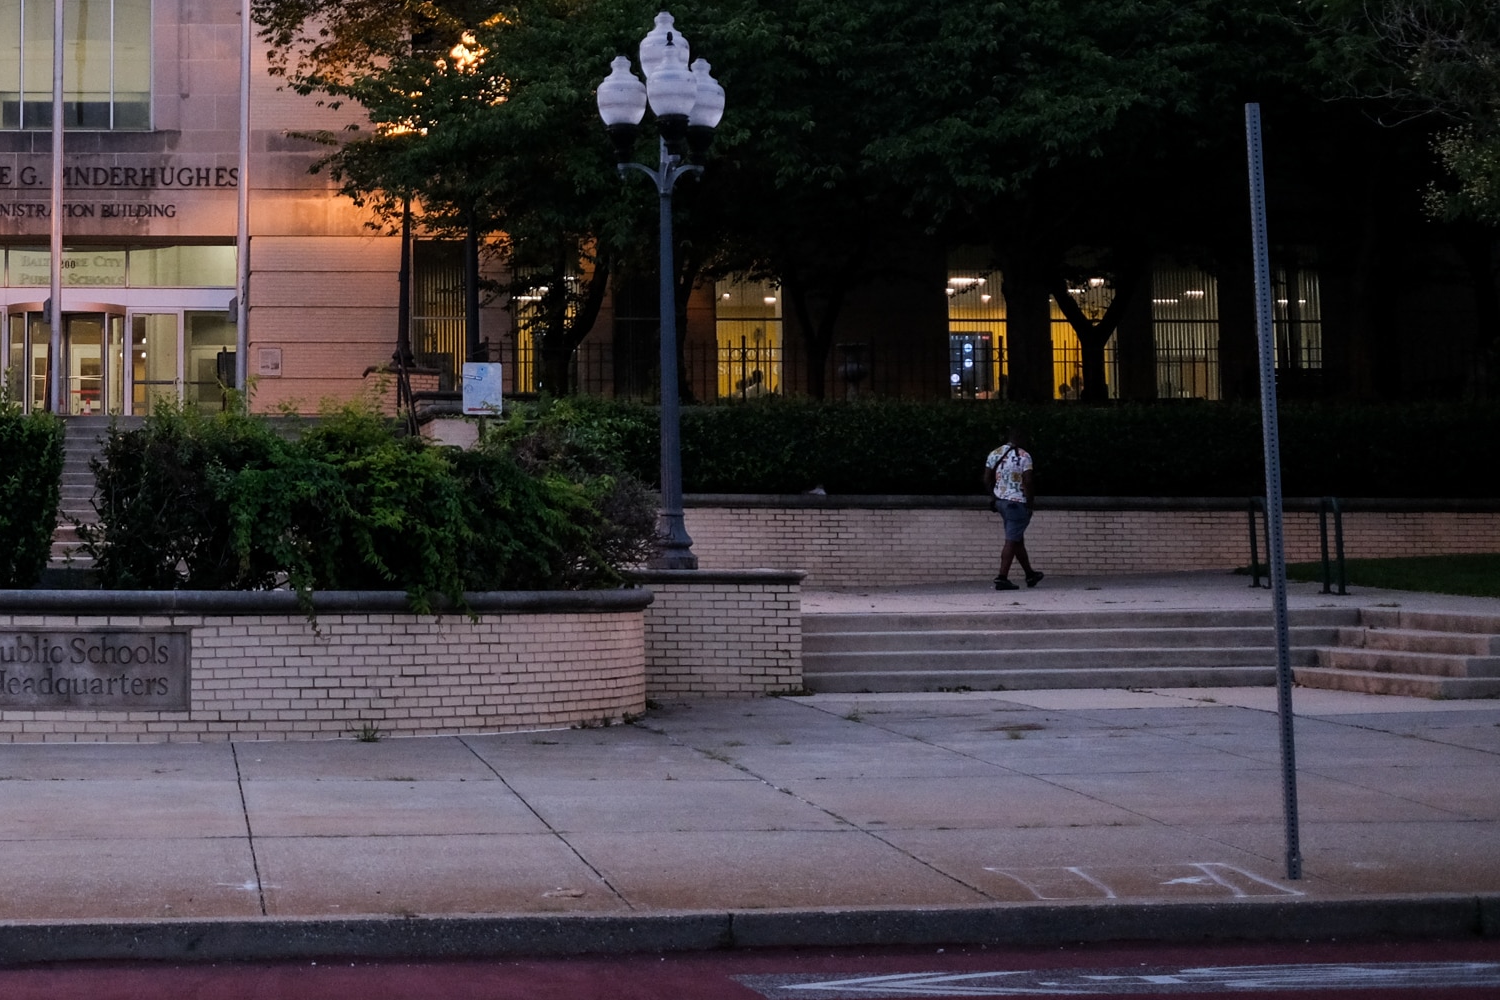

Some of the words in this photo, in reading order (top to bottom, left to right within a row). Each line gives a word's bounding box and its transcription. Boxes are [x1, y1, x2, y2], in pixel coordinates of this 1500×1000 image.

[20, 166, 43, 186] G.
[101, 204, 177, 218] BUILDING
[69, 636, 169, 665] Schools
